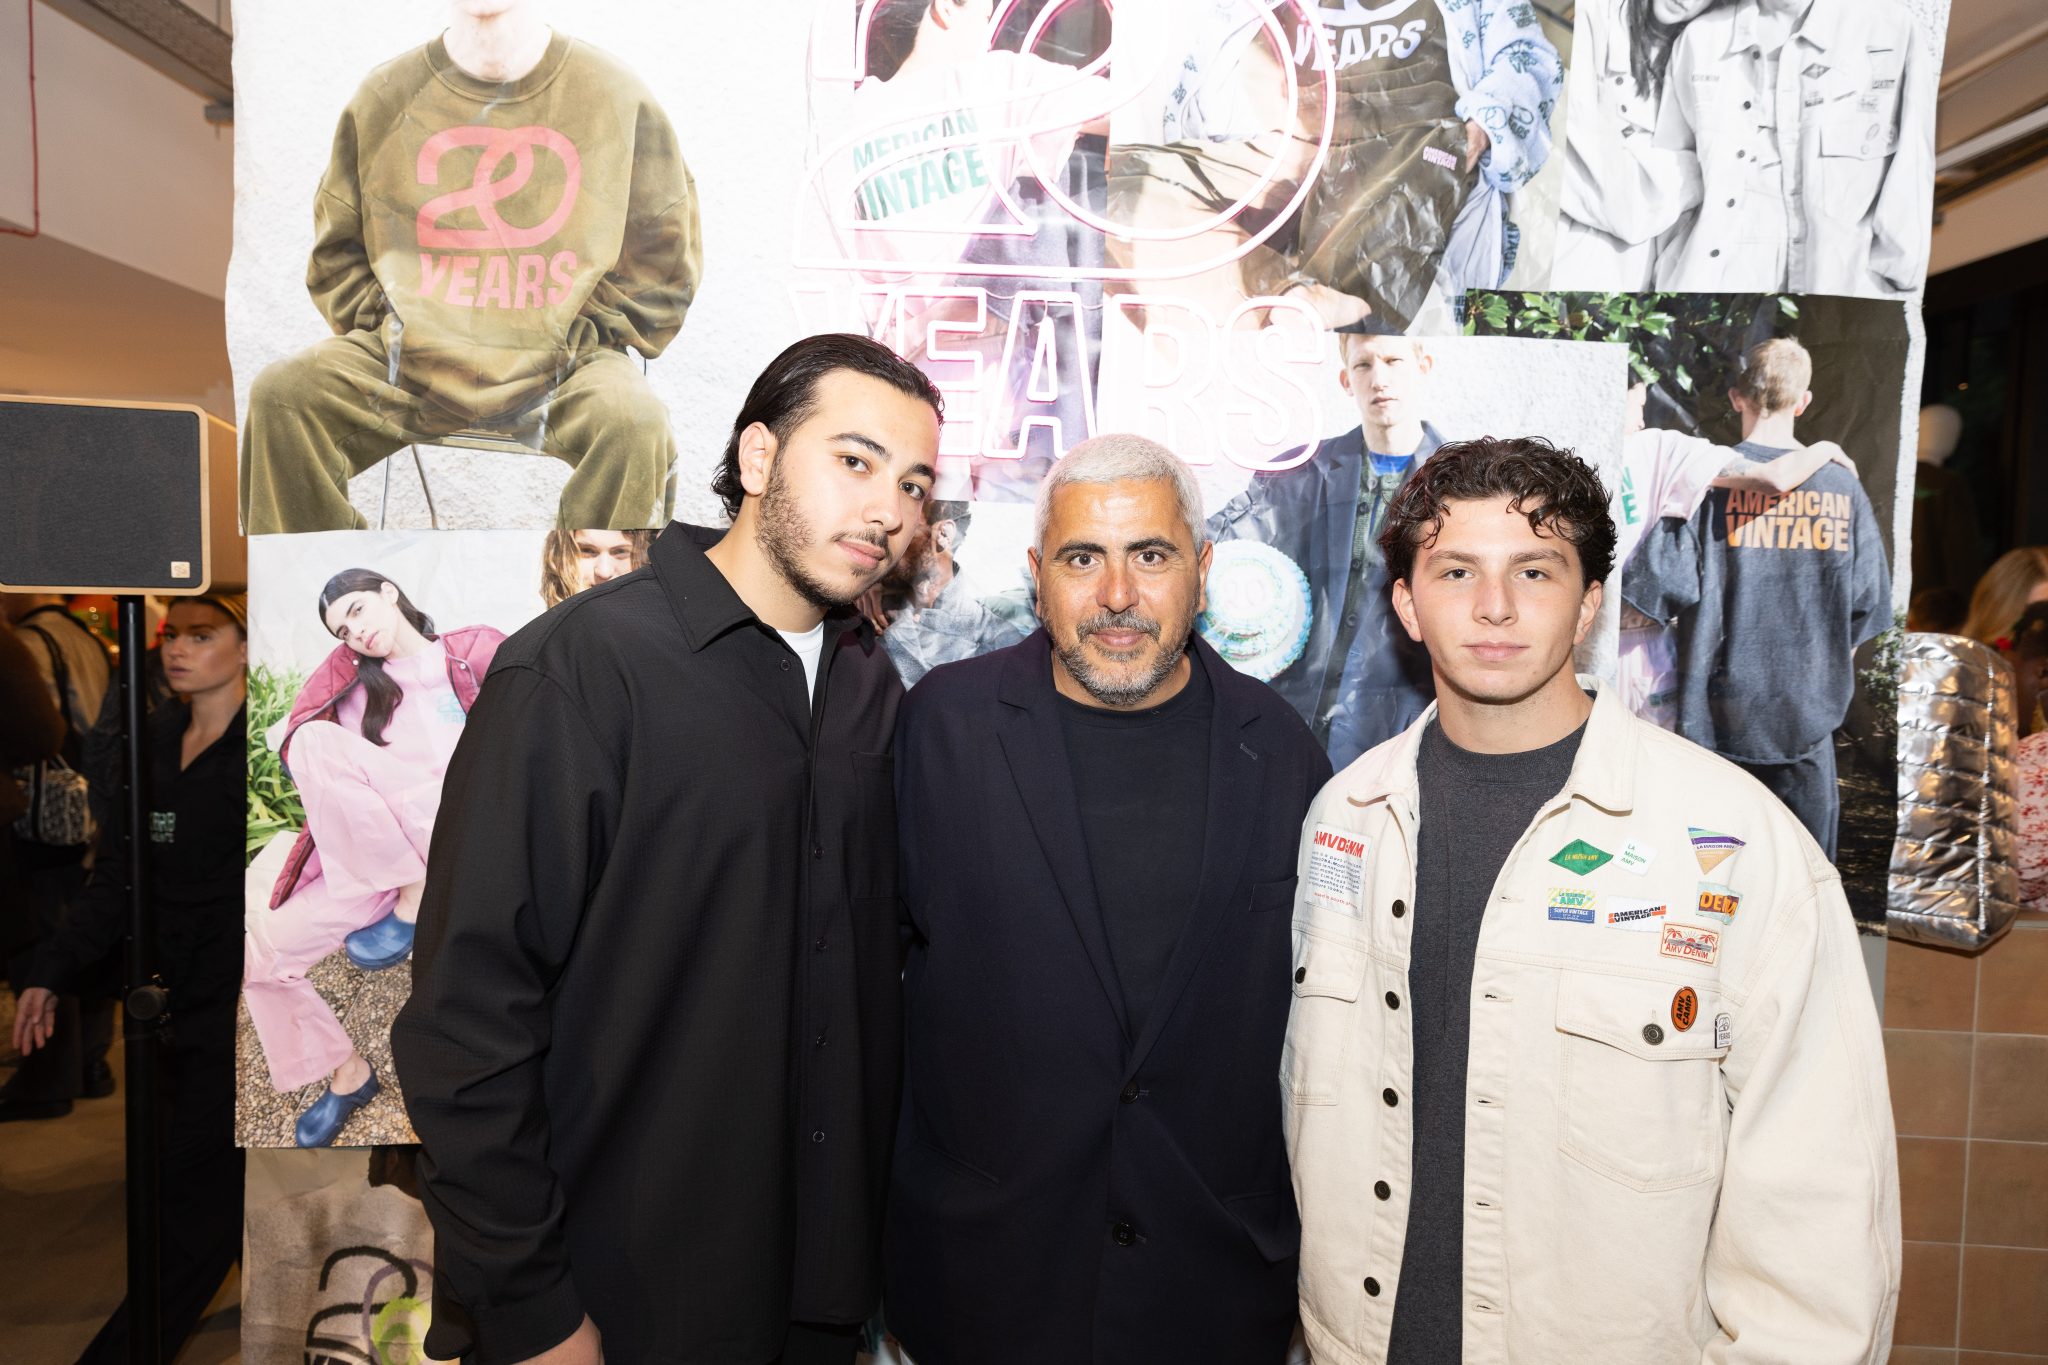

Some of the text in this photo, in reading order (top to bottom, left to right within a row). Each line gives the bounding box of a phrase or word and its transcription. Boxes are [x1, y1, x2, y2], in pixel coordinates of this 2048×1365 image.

[416, 125, 582, 250] 20
[416, 250, 578, 310] YEARS
[1724, 488, 1850, 520] AMERICAN
[1725, 514, 1850, 551] VINTAGE
[1624, 850, 1647, 864] MAISON
[1627, 843, 1636, 851] LA
[1620, 857, 1635, 867] AMV
[1613, 906, 1661, 917] AMERICAN
[1613, 913, 1652, 923] VINTAGE
[1676, 995, 1685, 1021] AMV
[1682, 995, 1692, 1026] CAMP
